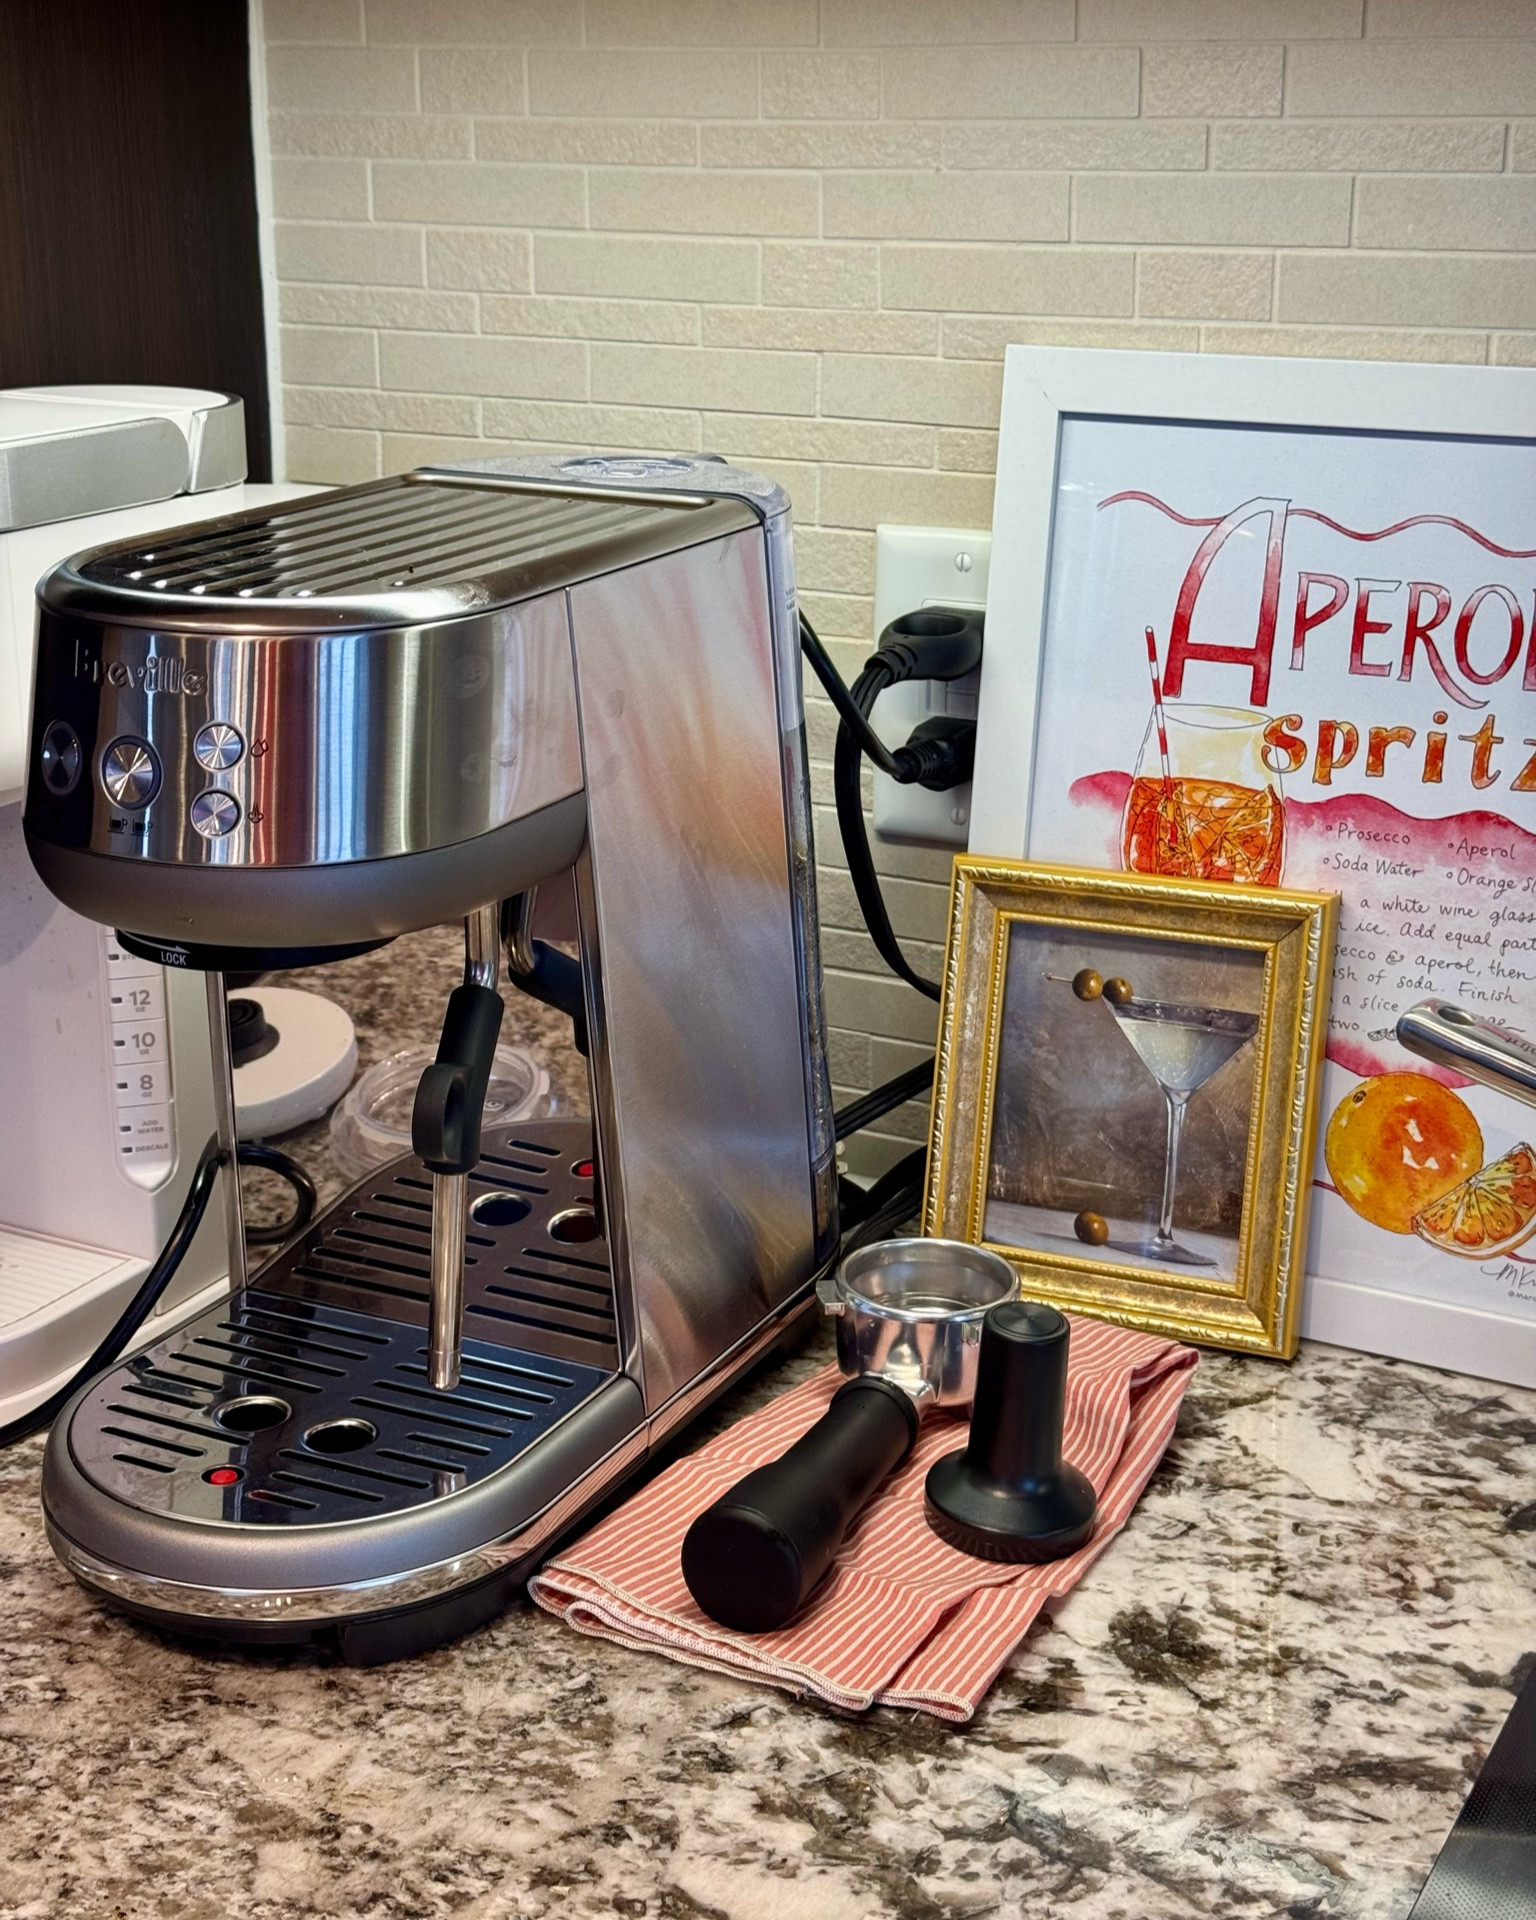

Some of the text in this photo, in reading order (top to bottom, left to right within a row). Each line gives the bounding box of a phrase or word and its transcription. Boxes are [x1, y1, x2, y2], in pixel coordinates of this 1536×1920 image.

[1337, 821, 1411, 845] Prosecco
[1456, 837, 1516, 861] Aperol
[1332, 852, 1424, 878] Soda Water
[1457, 867, 1517, 899] Orange
[1360, 895, 1536, 928] a white wine glass
[1445, 931, 1492, 951] equal
[160, 950, 187, 967] LOCK
[1488, 959, 1536, 981] then
[1367, 969, 1388, 985] of
[1458, 980, 1521, 1005] Finish
[128, 989, 152, 1007] 12
[1342, 994, 1351, 1005] a
[1359, 994, 1399, 1012] slice
[131, 1031, 156, 1049] 10
[140, 1074, 154, 1091] 8
[137, 1126, 164, 1135] WATER
[135, 1142, 169, 1153] DESCALE
